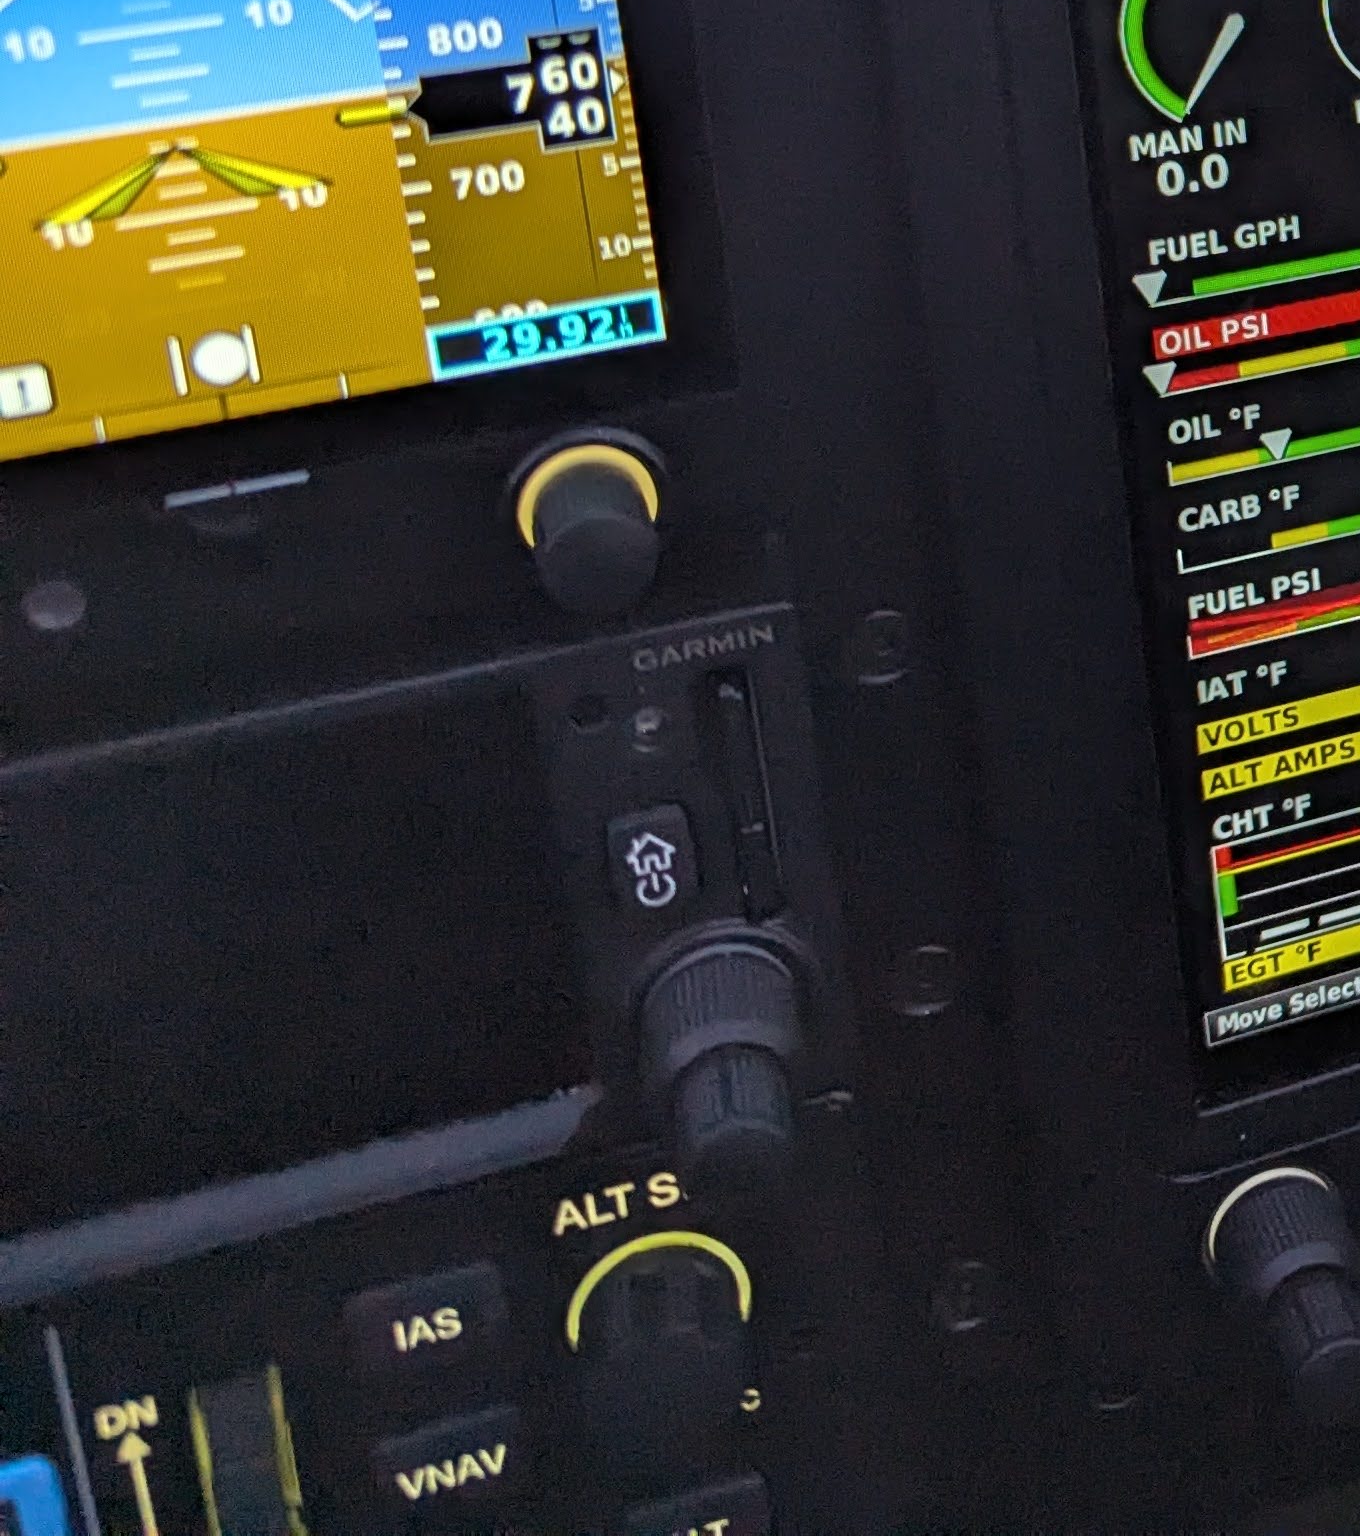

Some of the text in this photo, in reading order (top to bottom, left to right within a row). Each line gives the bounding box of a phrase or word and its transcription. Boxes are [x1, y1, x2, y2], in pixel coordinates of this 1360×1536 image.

[5, 27, 56, 64] 10
[427, 19, 504, 57] 800
[547, 96, 607, 139] 40
[1128, 117, 1248, 162] MAN IN
[449, 159, 526, 202] 700
[1156, 153, 1230, 197] 0.0
[599, 233, 632, 261] 10
[1148, 215, 1301, 265] FUEL GPH
[483, 308, 616, 363] 29.92
[1159, 313, 1270, 357] OIL PSI
[1168, 416, 1221, 446] OIL
[1178, 497, 1262, 533] CARB
[1187, 567, 1322, 620] FUEL PSI
[633, 625, 775, 672] GARMIN
[1197, 670, 1247, 706] IAT
[1203, 706, 1300, 749] VOLTS
[1209, 739, 1357, 795] ALT AMPS
[1211, 804, 1275, 840] CHT
[1230, 951, 1287, 987] EGT
[1217, 998, 1283, 1038] Move
[553, 1181, 636, 1237] ALT
[392, 1307, 464, 1353] IAS
[94, 1394, 159, 1441] DN
[397, 1444, 507, 1501] VNAV
